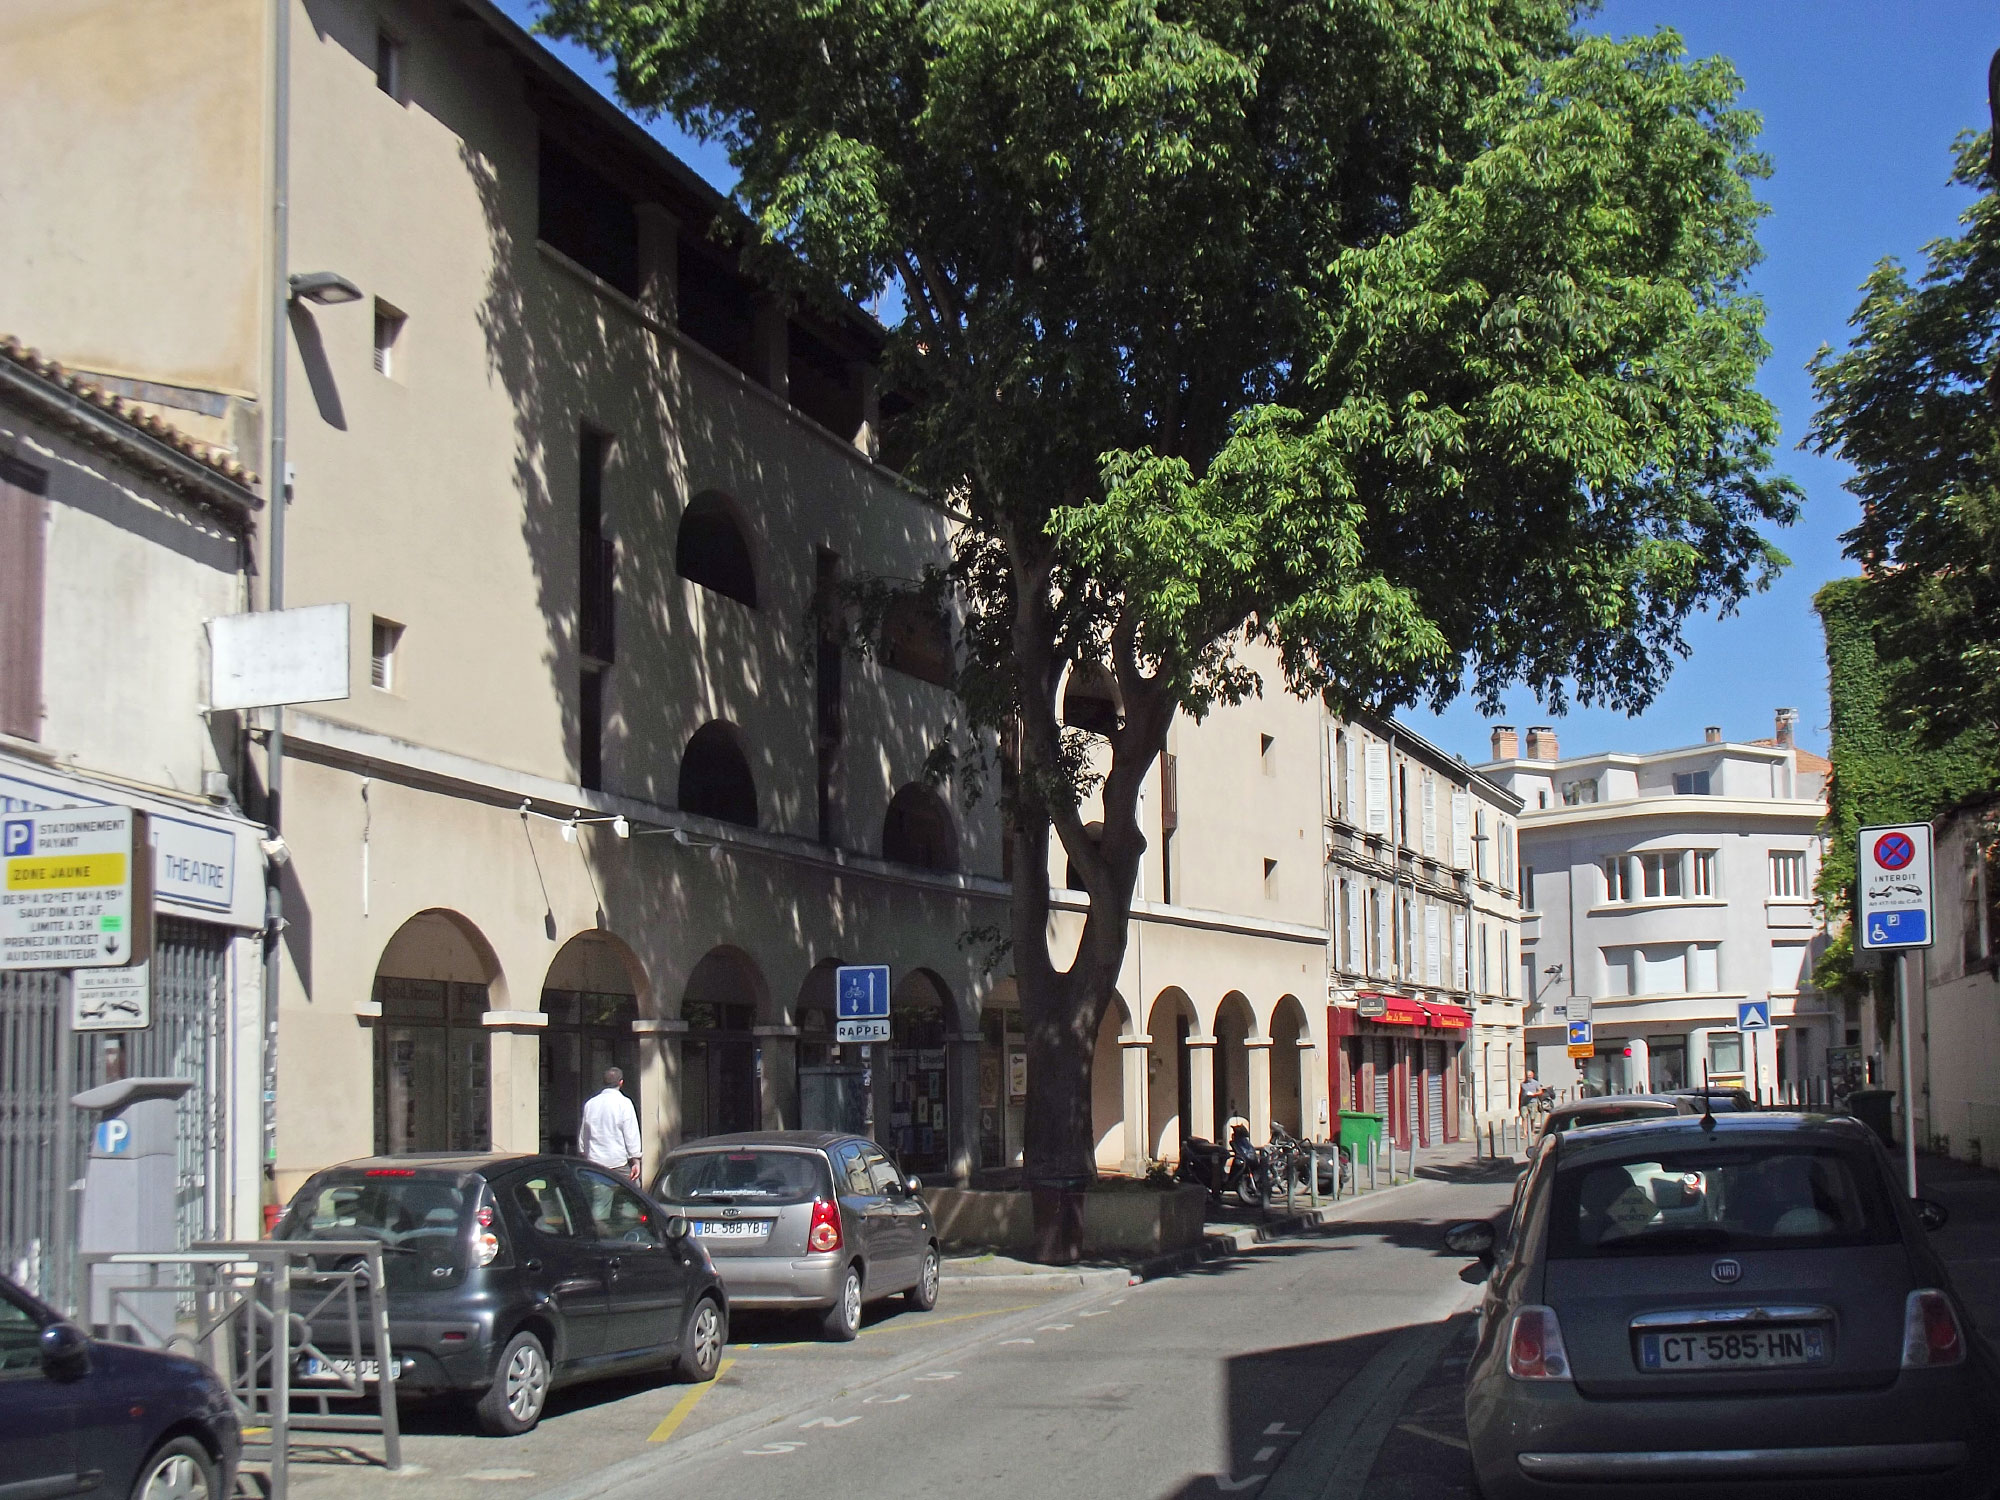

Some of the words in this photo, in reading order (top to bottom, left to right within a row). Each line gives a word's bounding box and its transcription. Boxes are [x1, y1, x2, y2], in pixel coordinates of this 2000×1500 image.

[39, 820, 125, 834] STATIONNEMENT
[39, 837, 79, 848] PAYANT
[14, 868, 46, 880] ZONE
[51, 866, 91, 878] JAUNE
[165, 854, 225, 889] THEATRE
[1874, 873, 1916, 882] INTERDIT
[20, 907, 47, 918] SAUF
[73, 906, 85, 916] ET
[32, 921, 64, 932] LIMITE
[4, 936, 45, 947] PRENEZ
[48, 935, 61, 945] UN
[63, 934, 99, 945] TICKET
[22, 949, 98, 960] DISTRIBUTEUR
[839, 1026, 887, 1036] RAPPEL
[1717, 1265, 1735, 1276] FIAT
[1663, 1333, 1803, 1362] CT-585-HN
